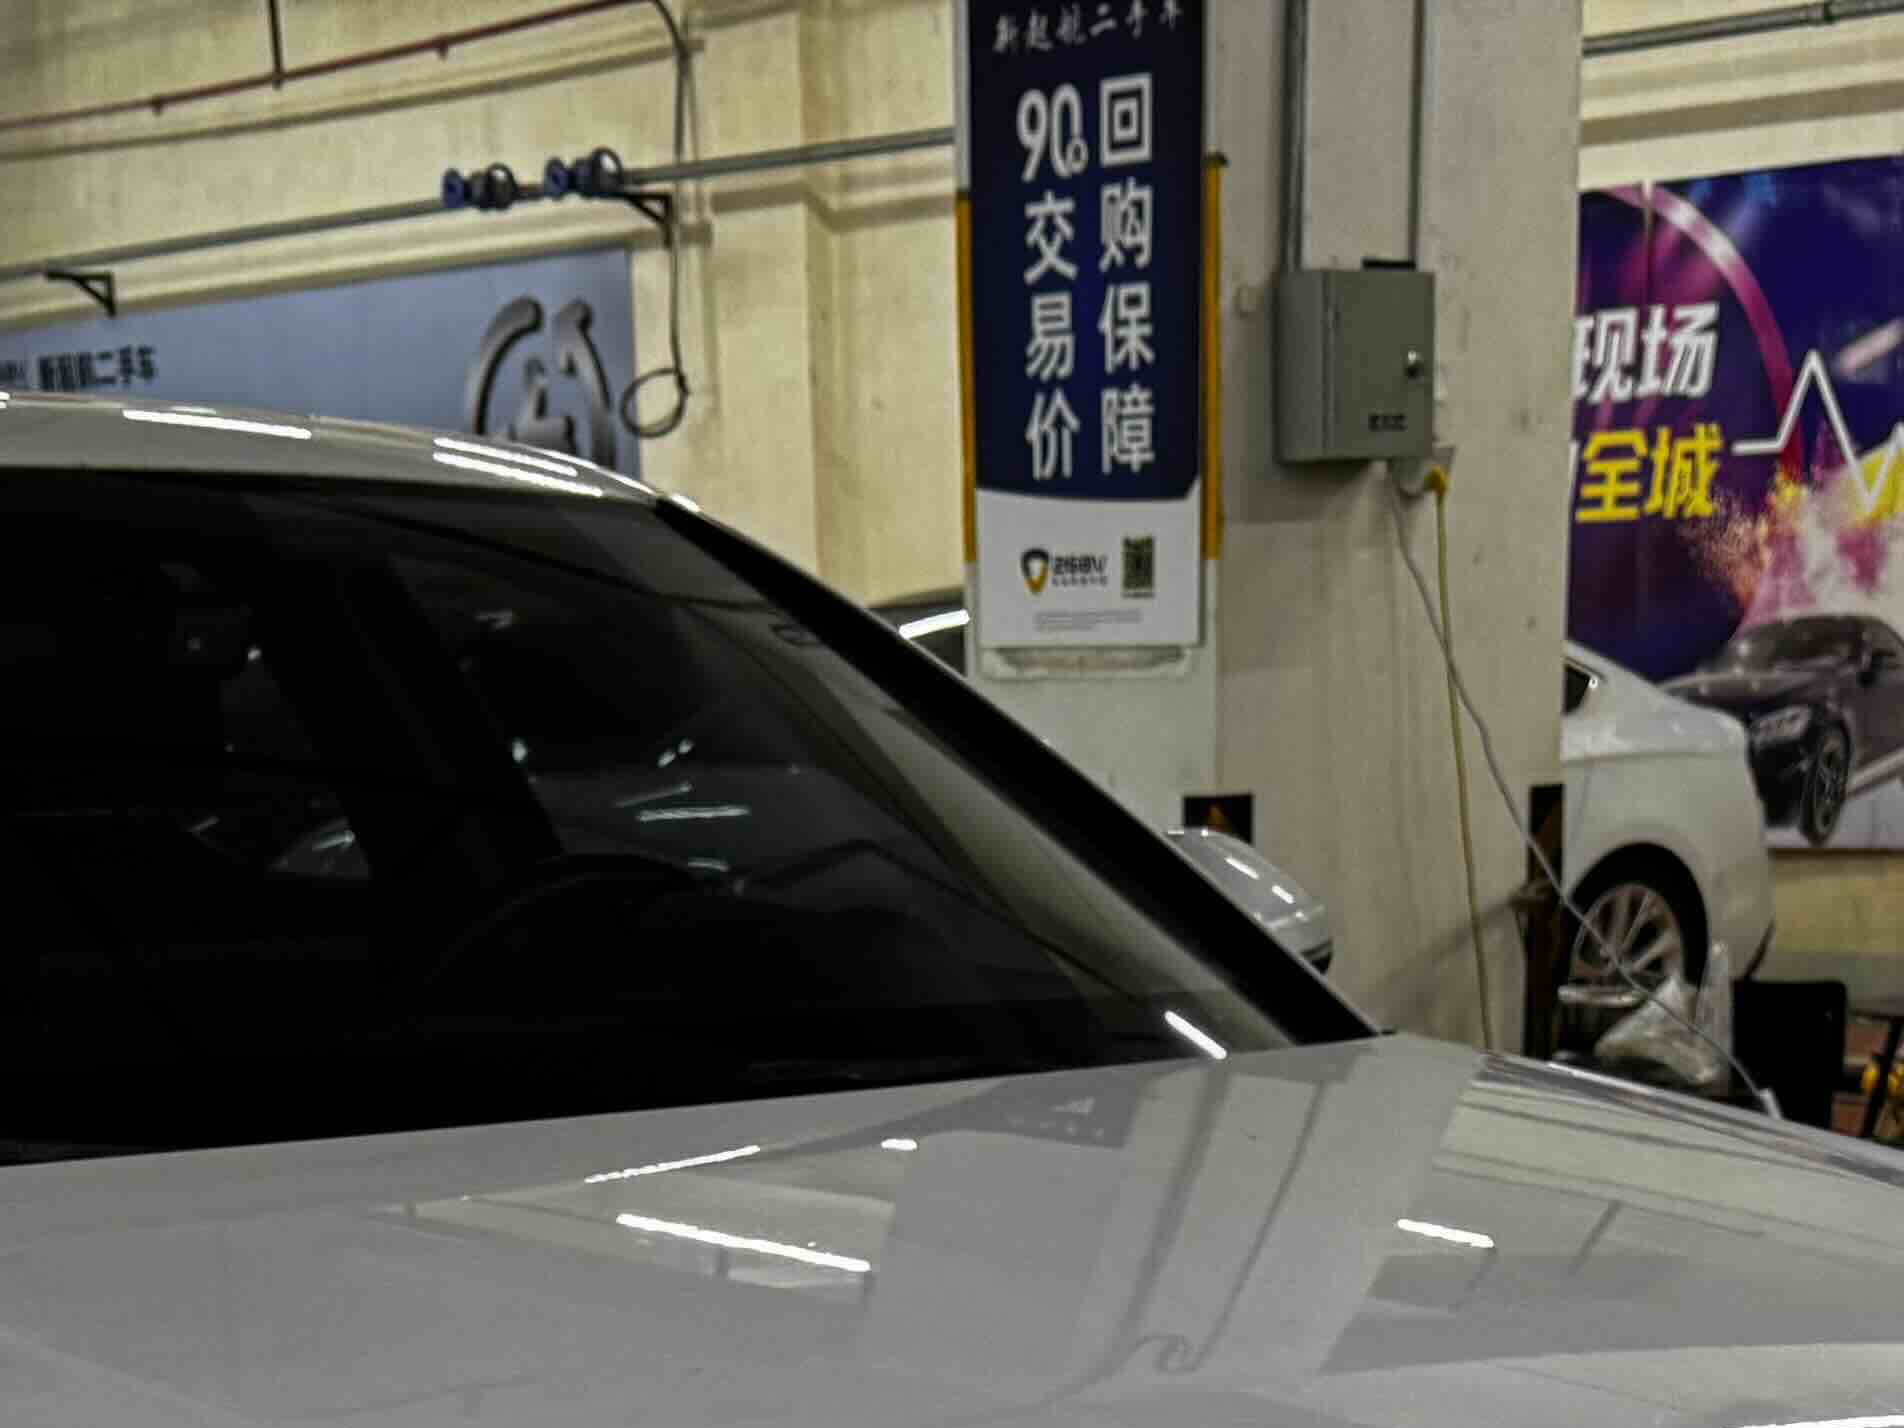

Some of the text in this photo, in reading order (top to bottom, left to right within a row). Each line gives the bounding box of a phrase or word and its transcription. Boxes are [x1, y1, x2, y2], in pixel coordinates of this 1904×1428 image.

[1097, 72, 1156, 475] 回购保障
[1570, 301, 1720, 404] 现场
[1569, 422, 1723, 522] 全城
